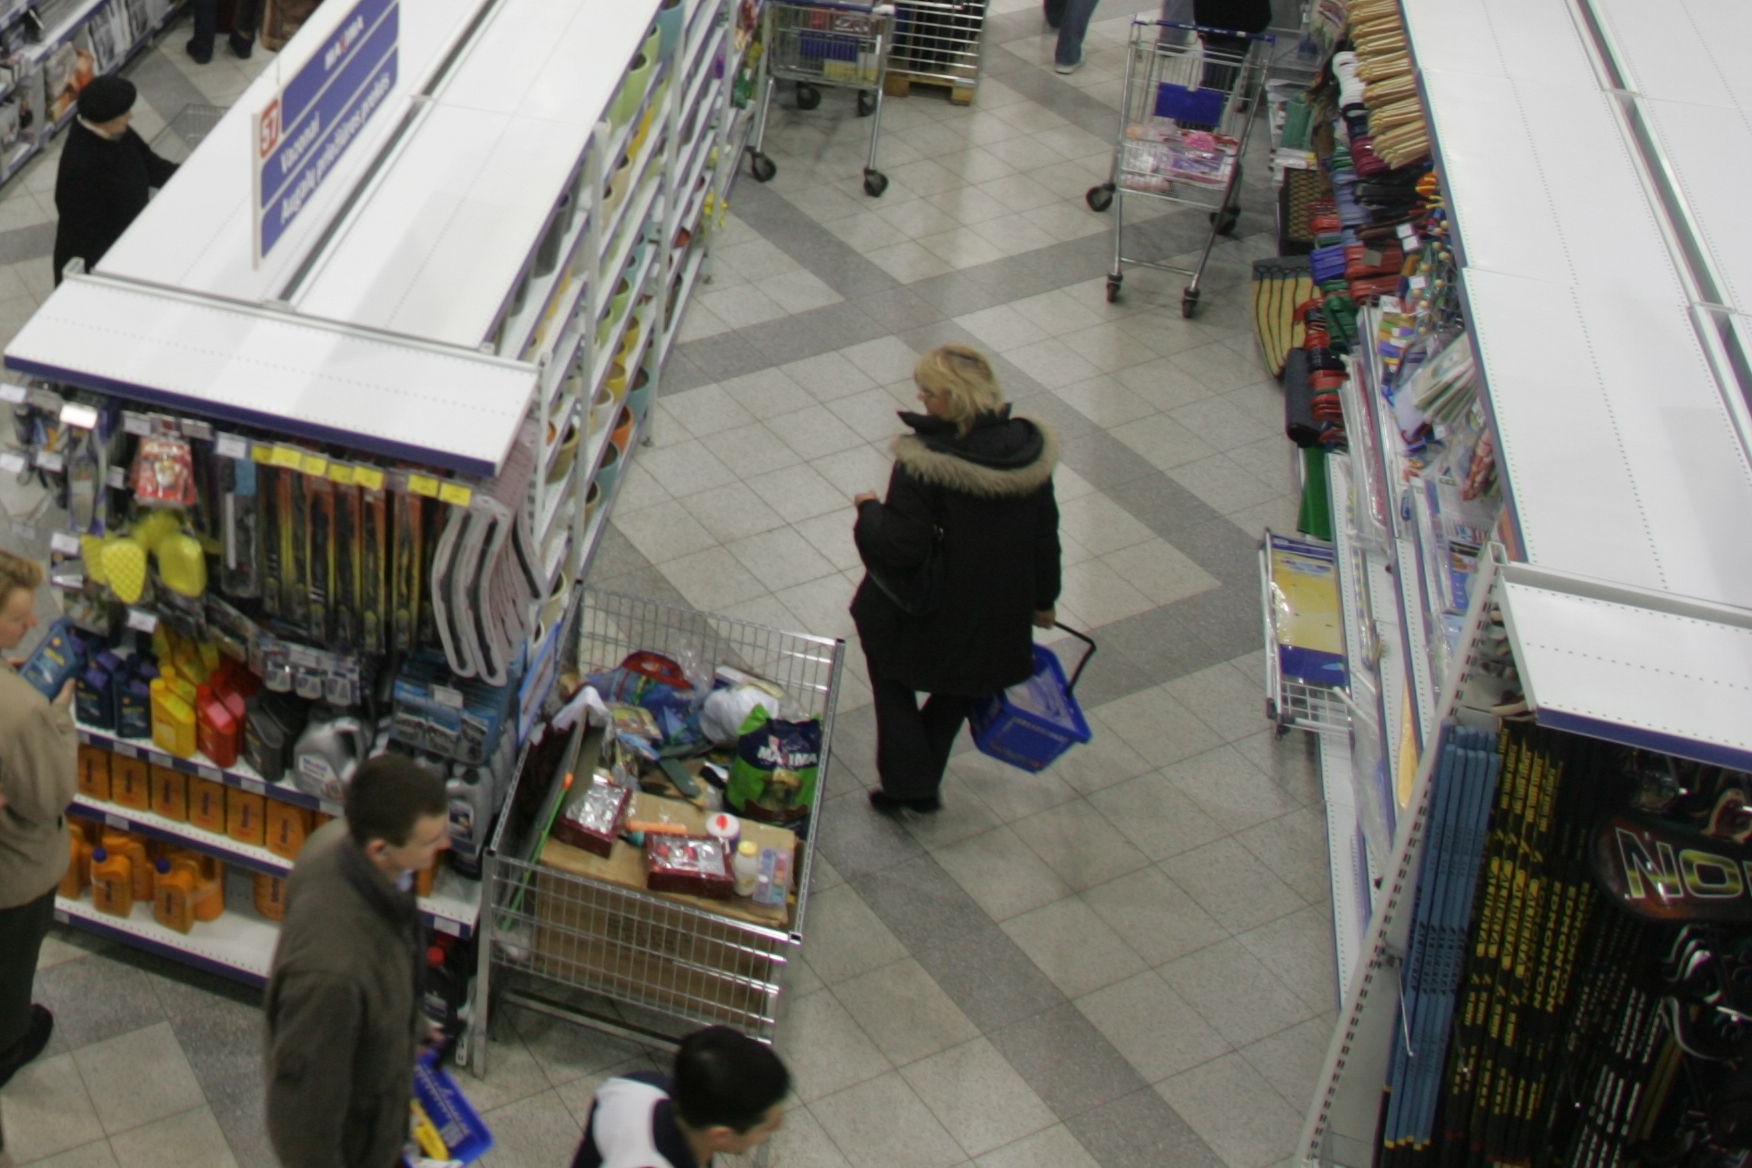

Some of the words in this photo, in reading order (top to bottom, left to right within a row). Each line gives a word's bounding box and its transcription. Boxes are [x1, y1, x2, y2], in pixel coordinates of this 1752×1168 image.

[1614, 826, 1752, 899] NO
[1533, 880, 1563, 1009] EDMONTON
[1546, 885, 1576, 1013] EDMONTON
